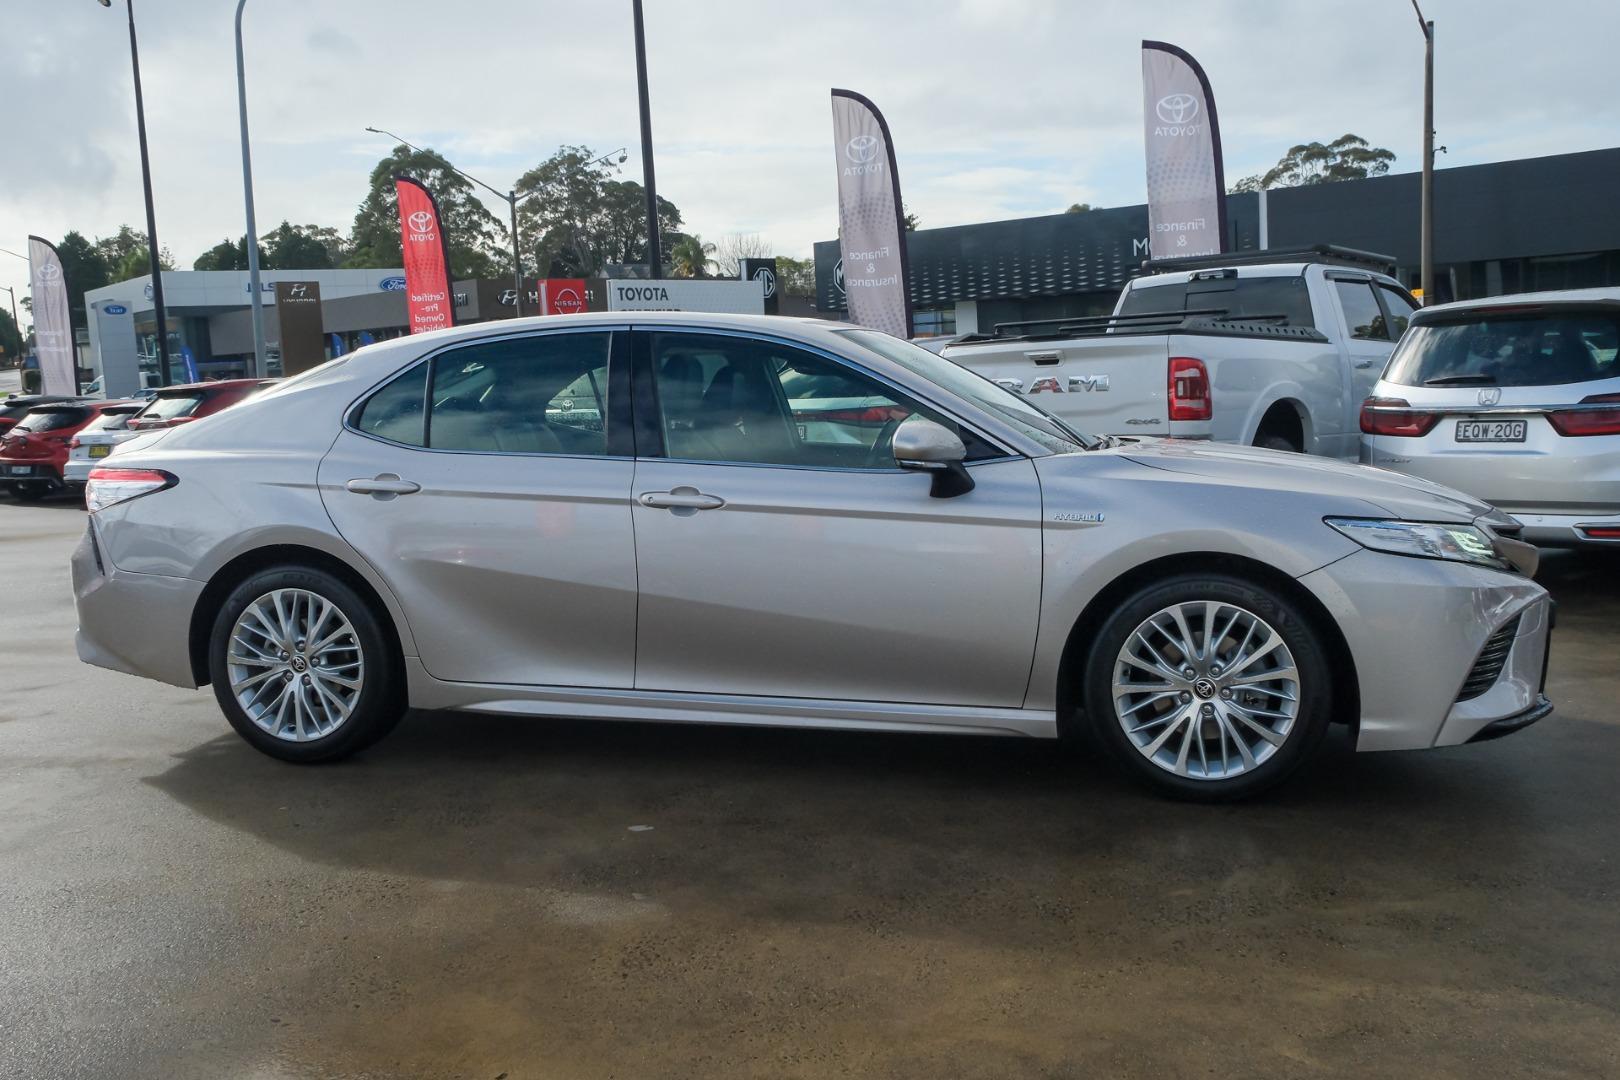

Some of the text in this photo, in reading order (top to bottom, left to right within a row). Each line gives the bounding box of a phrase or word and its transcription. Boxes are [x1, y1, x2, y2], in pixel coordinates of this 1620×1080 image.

[617, 287, 669, 301] TOYOTA
[554, 300, 582, 308] NISSAN
[990, 374, 1110, 395] RAM
[1054, 512, 1097, 521] HYBRID
